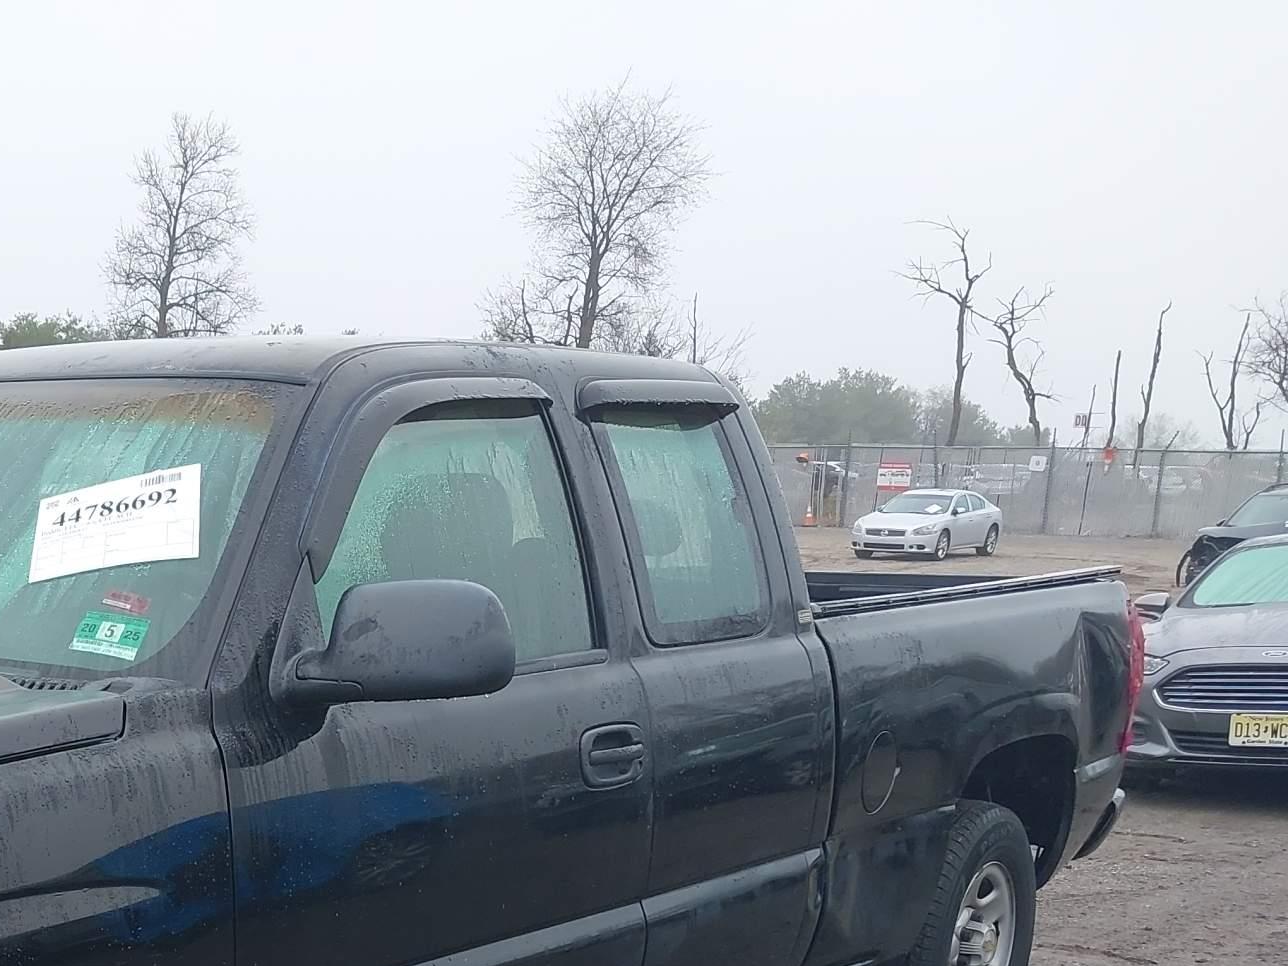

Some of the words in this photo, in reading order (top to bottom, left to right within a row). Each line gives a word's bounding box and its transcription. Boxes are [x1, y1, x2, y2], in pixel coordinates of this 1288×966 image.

[52, 488, 177, 527] 44786692
[81, 623, 97, 633] 20
[105, 624, 117, 638] 5
[123, 630, 141, 641] 25
